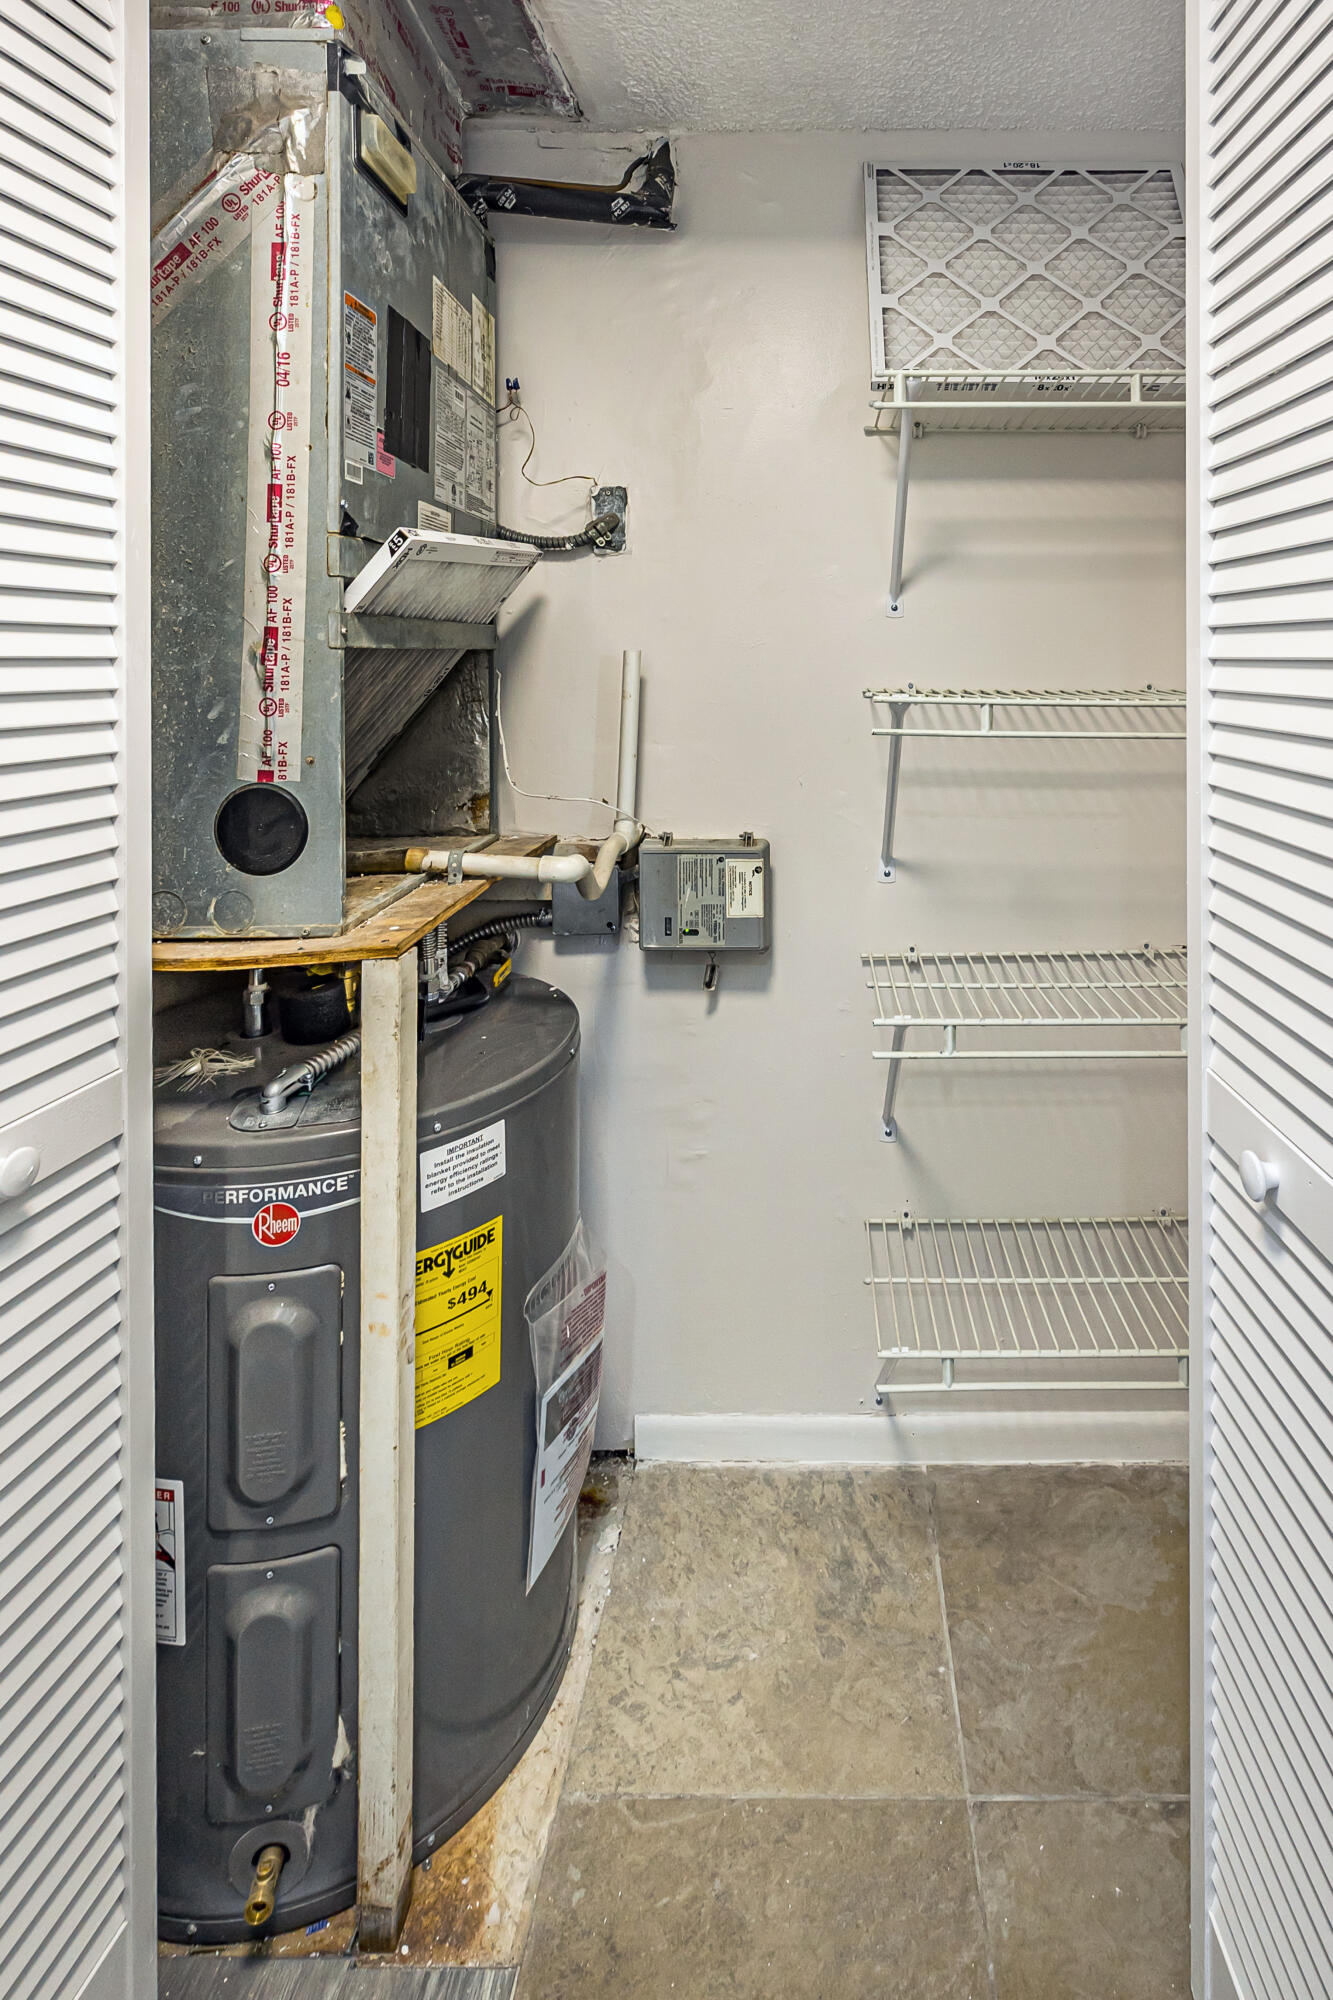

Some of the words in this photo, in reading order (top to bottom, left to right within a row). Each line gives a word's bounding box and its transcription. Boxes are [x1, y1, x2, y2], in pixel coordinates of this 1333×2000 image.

[221, 1, 240, 12] 100
[252, 175, 281, 207] 181A-P
[233, 204, 249, 222] LISTED
[187, 231, 201, 250] AF
[200, 216, 220, 236] 100
[290, 213, 301, 259] 181B-FX
[151, 275, 180, 307] 181A-P
[186, 236, 222, 273] 181B-FX
[290, 270, 300, 308] 181A-P
[288, 312, 296, 333] LISTED
[276, 351, 292, 388] 04/16
[286, 455, 297, 500] 181B-FX
[285, 511, 295, 549] 181A-P
[392, 535, 404, 546] 5
[267, 585, 279, 606] 100
[267, 607, 278, 623] AF
[282, 597, 293, 642] 181B-FX
[280, 653, 291, 692] 181A-P
[277, 697, 285, 718] LISTED
[262, 729, 273, 750] 100
[262, 750, 272, 767] AF
[446, 1134, 484, 1155] IMPORTANT
[455, 1152, 466, 1161] the
[466, 1139, 495, 1155] insulation
[424, 1177, 448, 1189] energy
[449, 1163, 479, 1180] efficiency
[426, 1166, 452, 1180] blanket
[452, 1154, 479, 1171] provided
[486, 1143, 501, 1154] meet
[430, 1185, 447, 1196] refer
[455, 1177, 466, 1185] the
[466, 1161, 498, 1179] installation
[448, 1177, 484, 1197] instructions
[258, 1204, 298, 1240] Rheem
[447, 1280, 488, 1310] $494
